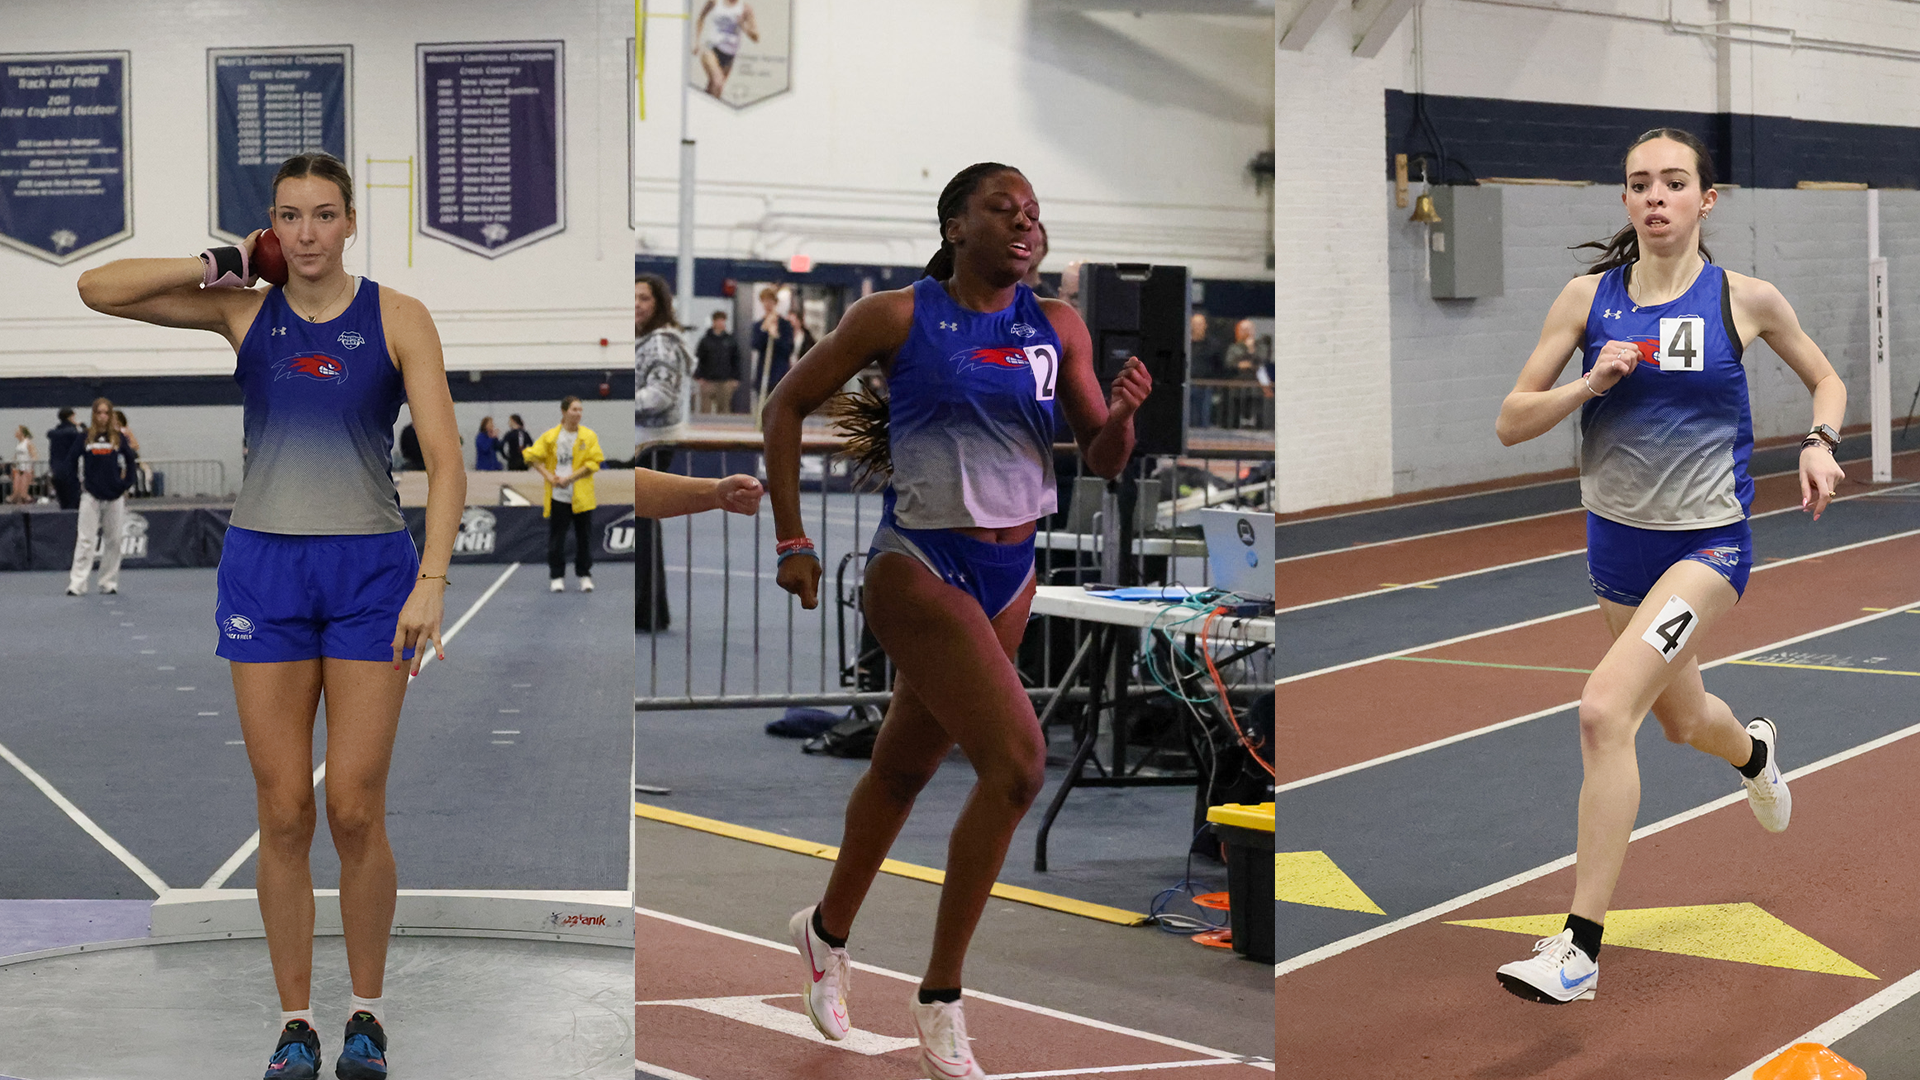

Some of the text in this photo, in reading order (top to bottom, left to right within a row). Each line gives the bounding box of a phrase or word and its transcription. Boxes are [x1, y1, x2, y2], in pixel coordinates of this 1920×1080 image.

[245, 57, 293, 66] Conference
[464, 54, 508, 62] Conference
[8, 64, 110, 77] Women's Champions
[275, 70, 311, 80] Country
[460, 66, 522, 76] Cross Country
[19, 76, 101, 89] Track and Field
[0, 106, 118, 118] New England Outdoor
[1876, 275, 1884, 364] FINISH
[1667, 321, 1698, 369] 4
[1034, 347, 1054, 397] 2
[1655, 610, 1693, 655] 4
